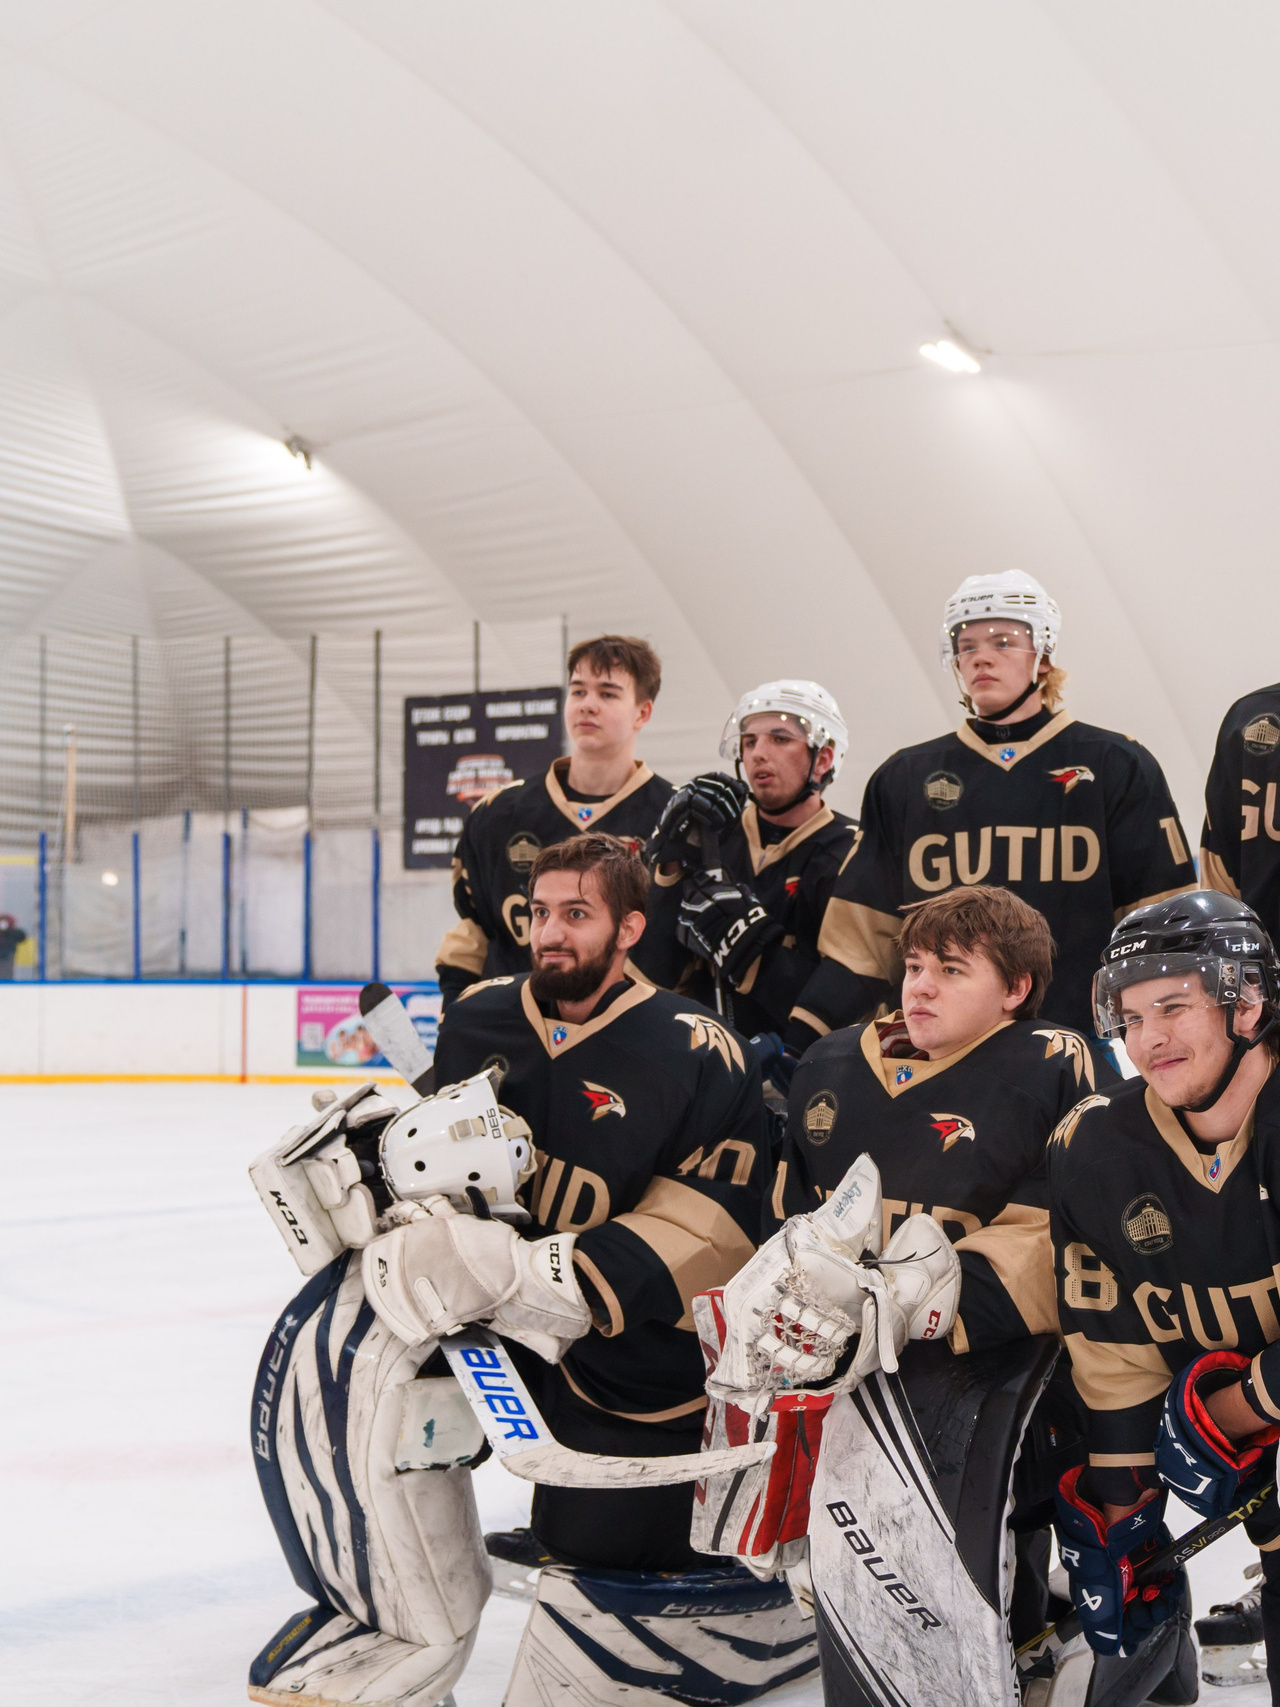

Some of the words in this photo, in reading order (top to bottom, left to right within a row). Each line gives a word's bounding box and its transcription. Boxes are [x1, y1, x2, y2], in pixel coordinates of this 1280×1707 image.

[908, 825, 1100, 892] GUTID
[713, 906, 767, 968] CCM
[1110, 939, 1148, 959] CCM
[1231, 942, 1260, 953] CCM
[486, 1108, 502, 1140] 930
[270, 1190, 308, 1245] CCM
[549, 1242, 563, 1284] CCM
[921, 1310, 941, 1340] CC
[460, 1348, 539, 1439] AUER
[826, 1501, 942, 1631] BAUER
